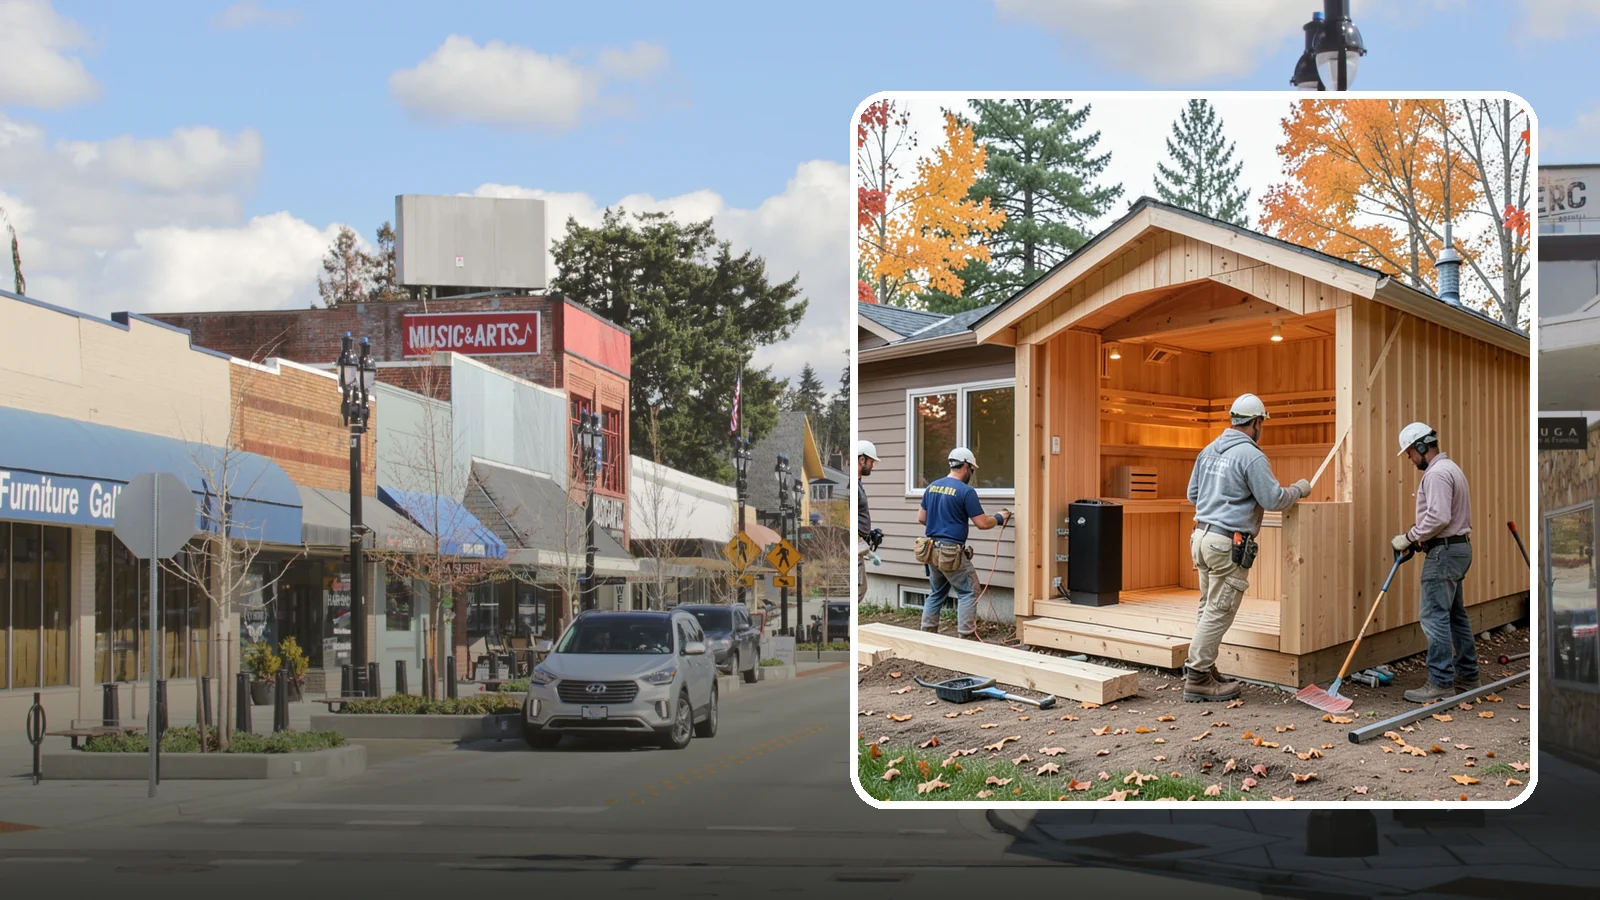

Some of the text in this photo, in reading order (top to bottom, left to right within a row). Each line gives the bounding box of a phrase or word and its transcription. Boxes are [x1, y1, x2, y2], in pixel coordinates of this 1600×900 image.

[409, 323, 520, 349] MUSIC&ARTS
[0, 471, 122, 519] Furniture Gal
[454, 562, 480, 575] SUSHI
